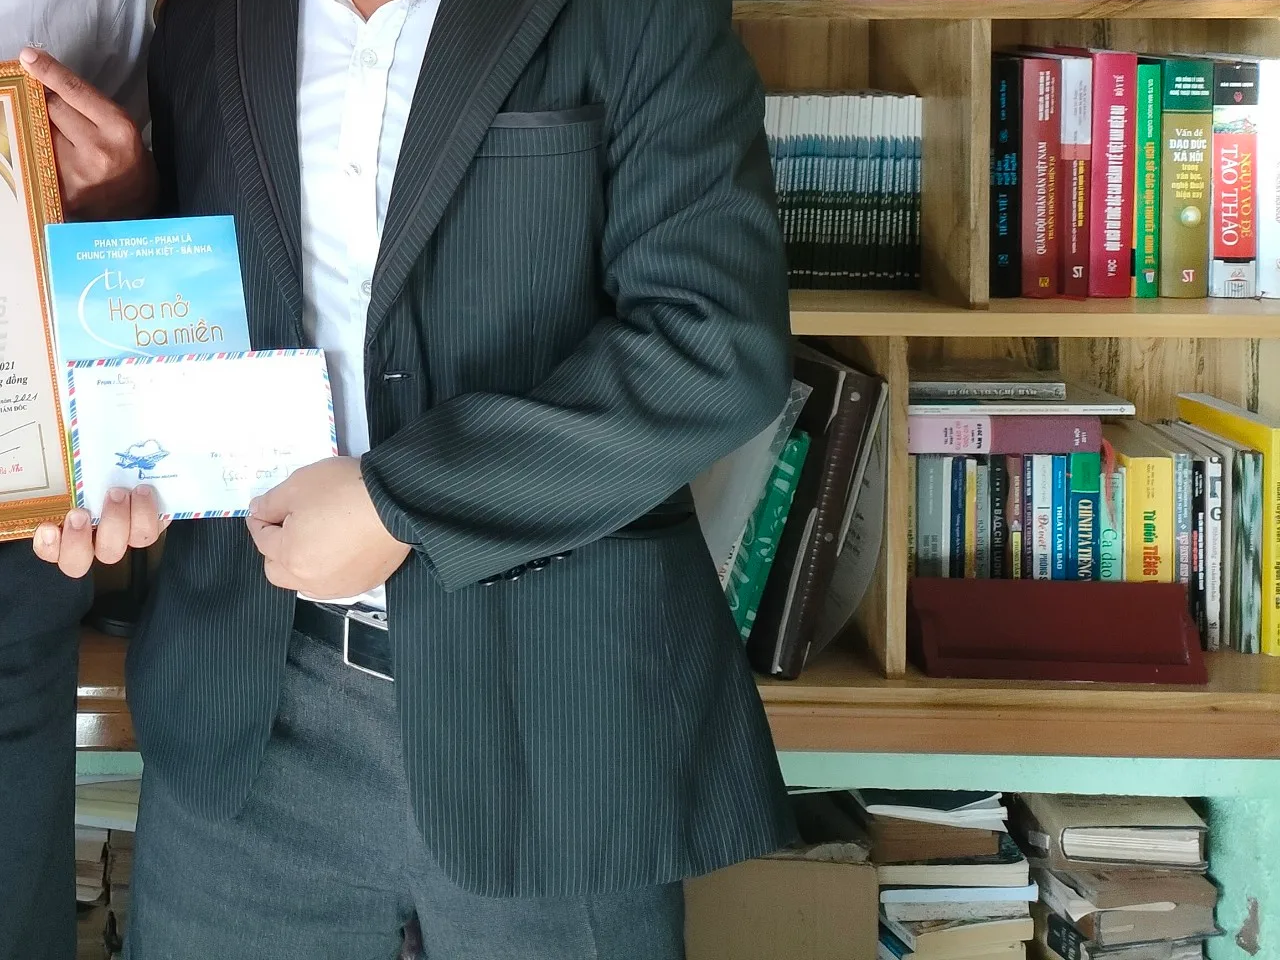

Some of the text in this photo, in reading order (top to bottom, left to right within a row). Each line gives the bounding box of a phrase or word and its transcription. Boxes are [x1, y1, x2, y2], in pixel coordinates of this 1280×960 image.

[1176, 128, 1192, 137] Vấn
[1221, 144, 1241, 246] TÀO THÁO
[94, 233, 192, 248] PHAN TRỌNG PHẠM LÀ
[77, 245, 212, 260] CHUNG THÚY ANH KIỆT BÁ NHA
[104, 268, 146, 290] thơ
[108, 294, 190, 321] Hoa nở
[135, 319, 224, 347] ba miền
[5, 372, 28, 386] đồng
[1101, 528, 1117, 578] Ca dao
